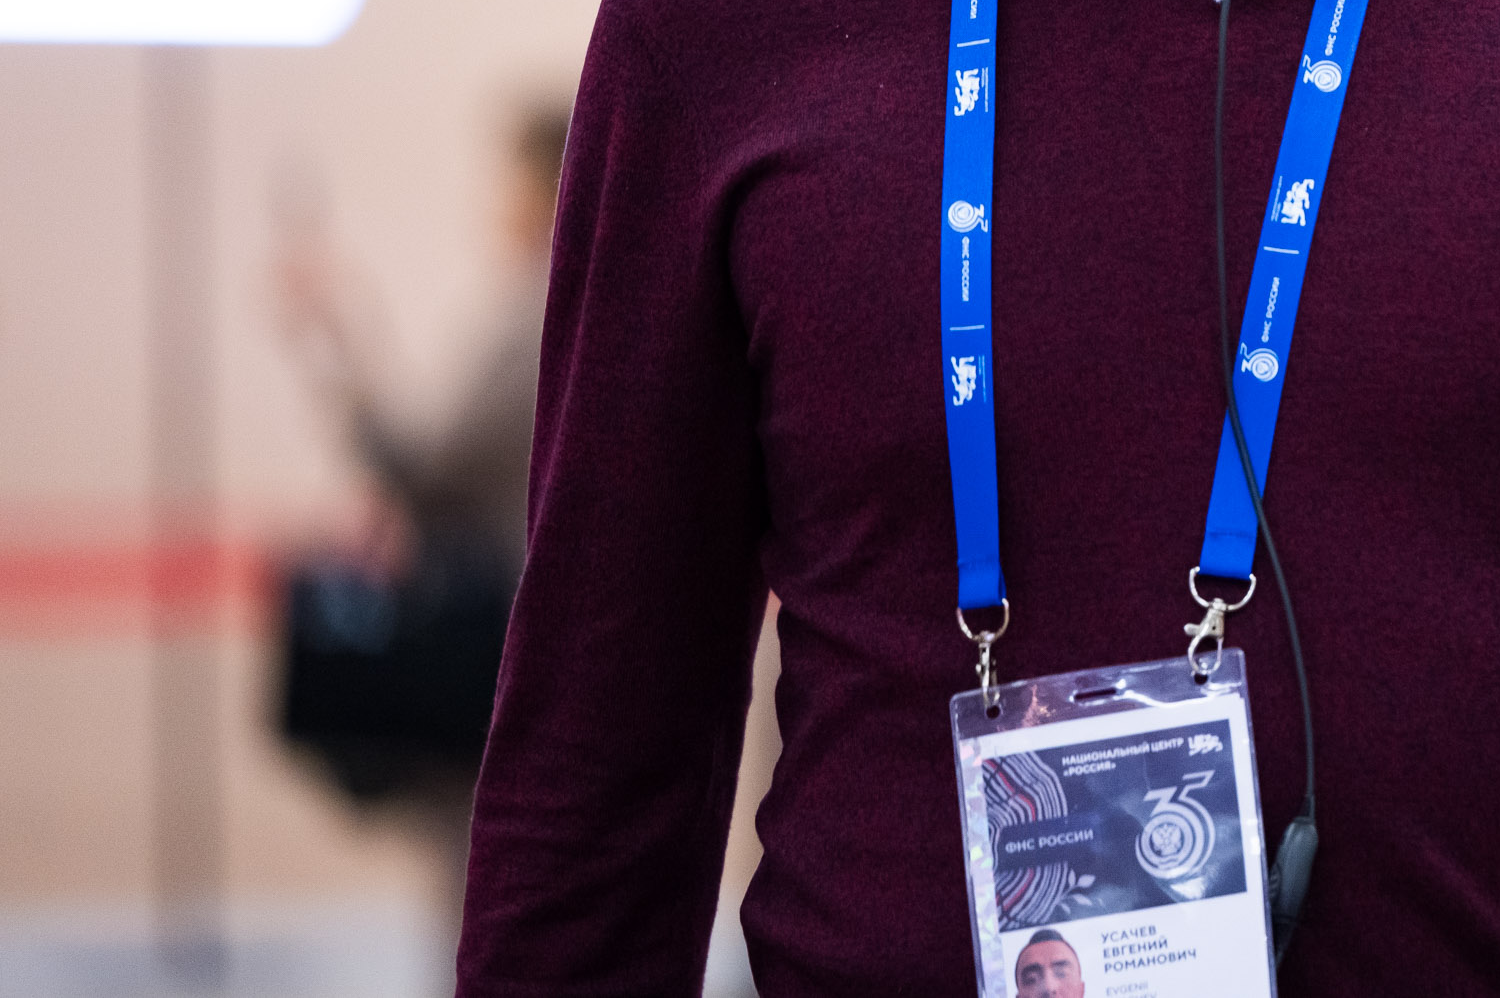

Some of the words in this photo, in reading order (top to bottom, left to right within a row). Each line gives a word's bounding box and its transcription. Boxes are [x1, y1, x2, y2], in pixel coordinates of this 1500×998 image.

[961, 260, 970, 302] РОССИИ
[1265, 276, 1280, 319] РОССИИ
[1061, 740, 1150, 766] НАЦИОНАЛЬНЫЙ
[1151, 736, 1184, 753] ЦЕНТР
[1063, 760, 1117, 777] «РОССИЯ»
[1004, 838, 1035, 854] ФНС
[1038, 828, 1094, 849] РОССИИ
[1101, 925, 1157, 944] УСАЧЕВ
[1103, 934, 1168, 959] ЕВГЕНИЙ
[1104, 948, 1197, 974] РОМАНОВИЧ
